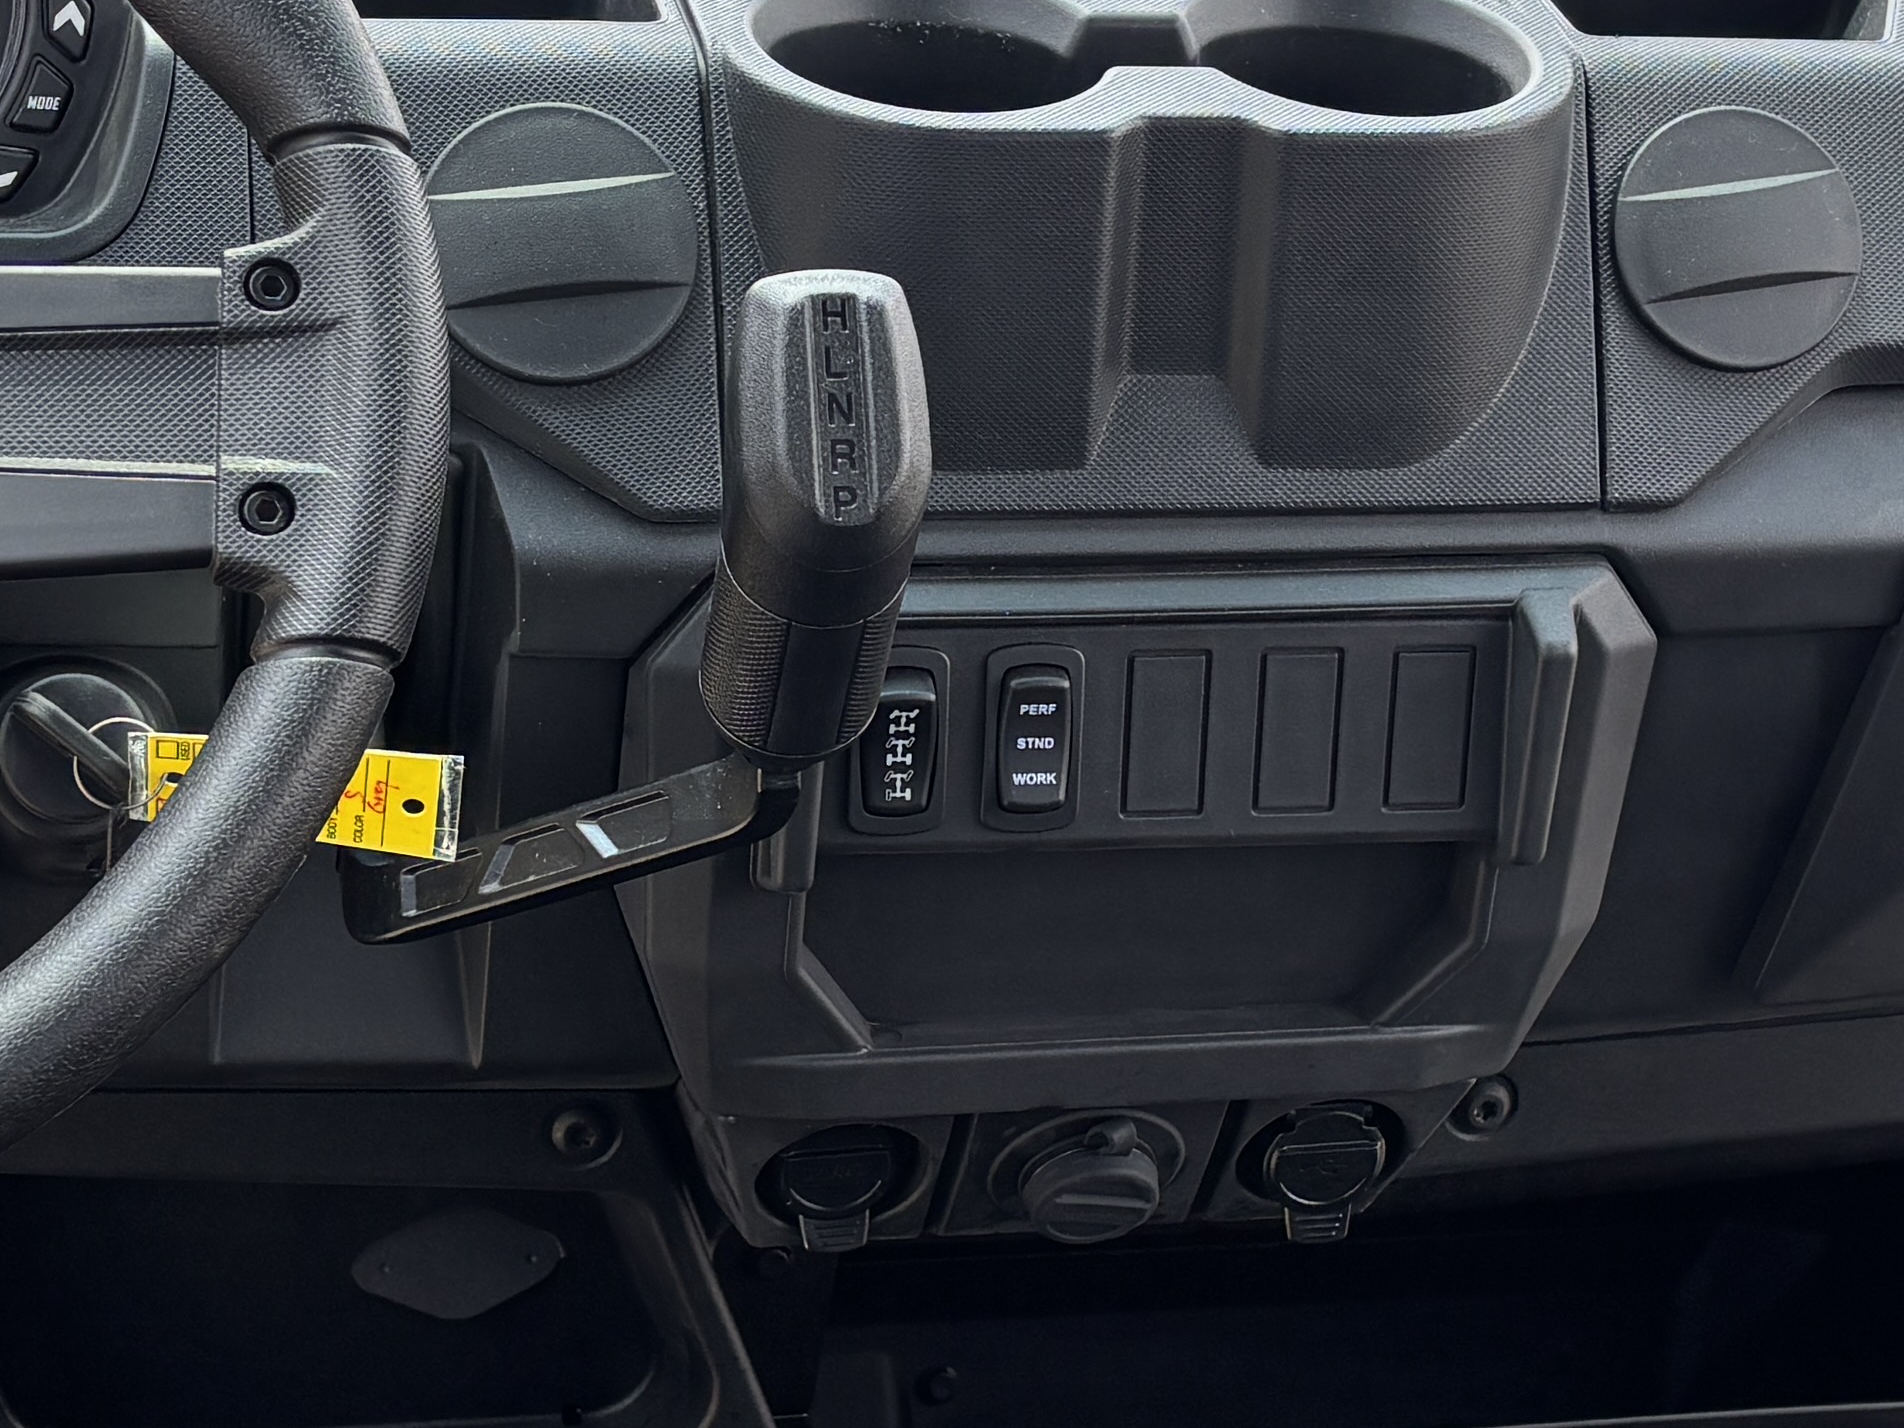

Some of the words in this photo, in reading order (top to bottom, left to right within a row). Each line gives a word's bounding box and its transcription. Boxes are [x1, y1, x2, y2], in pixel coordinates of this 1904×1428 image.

[27, 96, 61, 110] MODE
[822, 299, 849, 333] H
[825, 345, 848, 381] L
[827, 392, 855, 427] N
[831, 439, 859, 474] R
[833, 486, 857, 521] P
[1019, 704, 1057, 715] PERF
[1016, 738, 1055, 749] STND
[1013, 773, 1057, 785] WORK
[353, 815, 364, 843] COLOR
